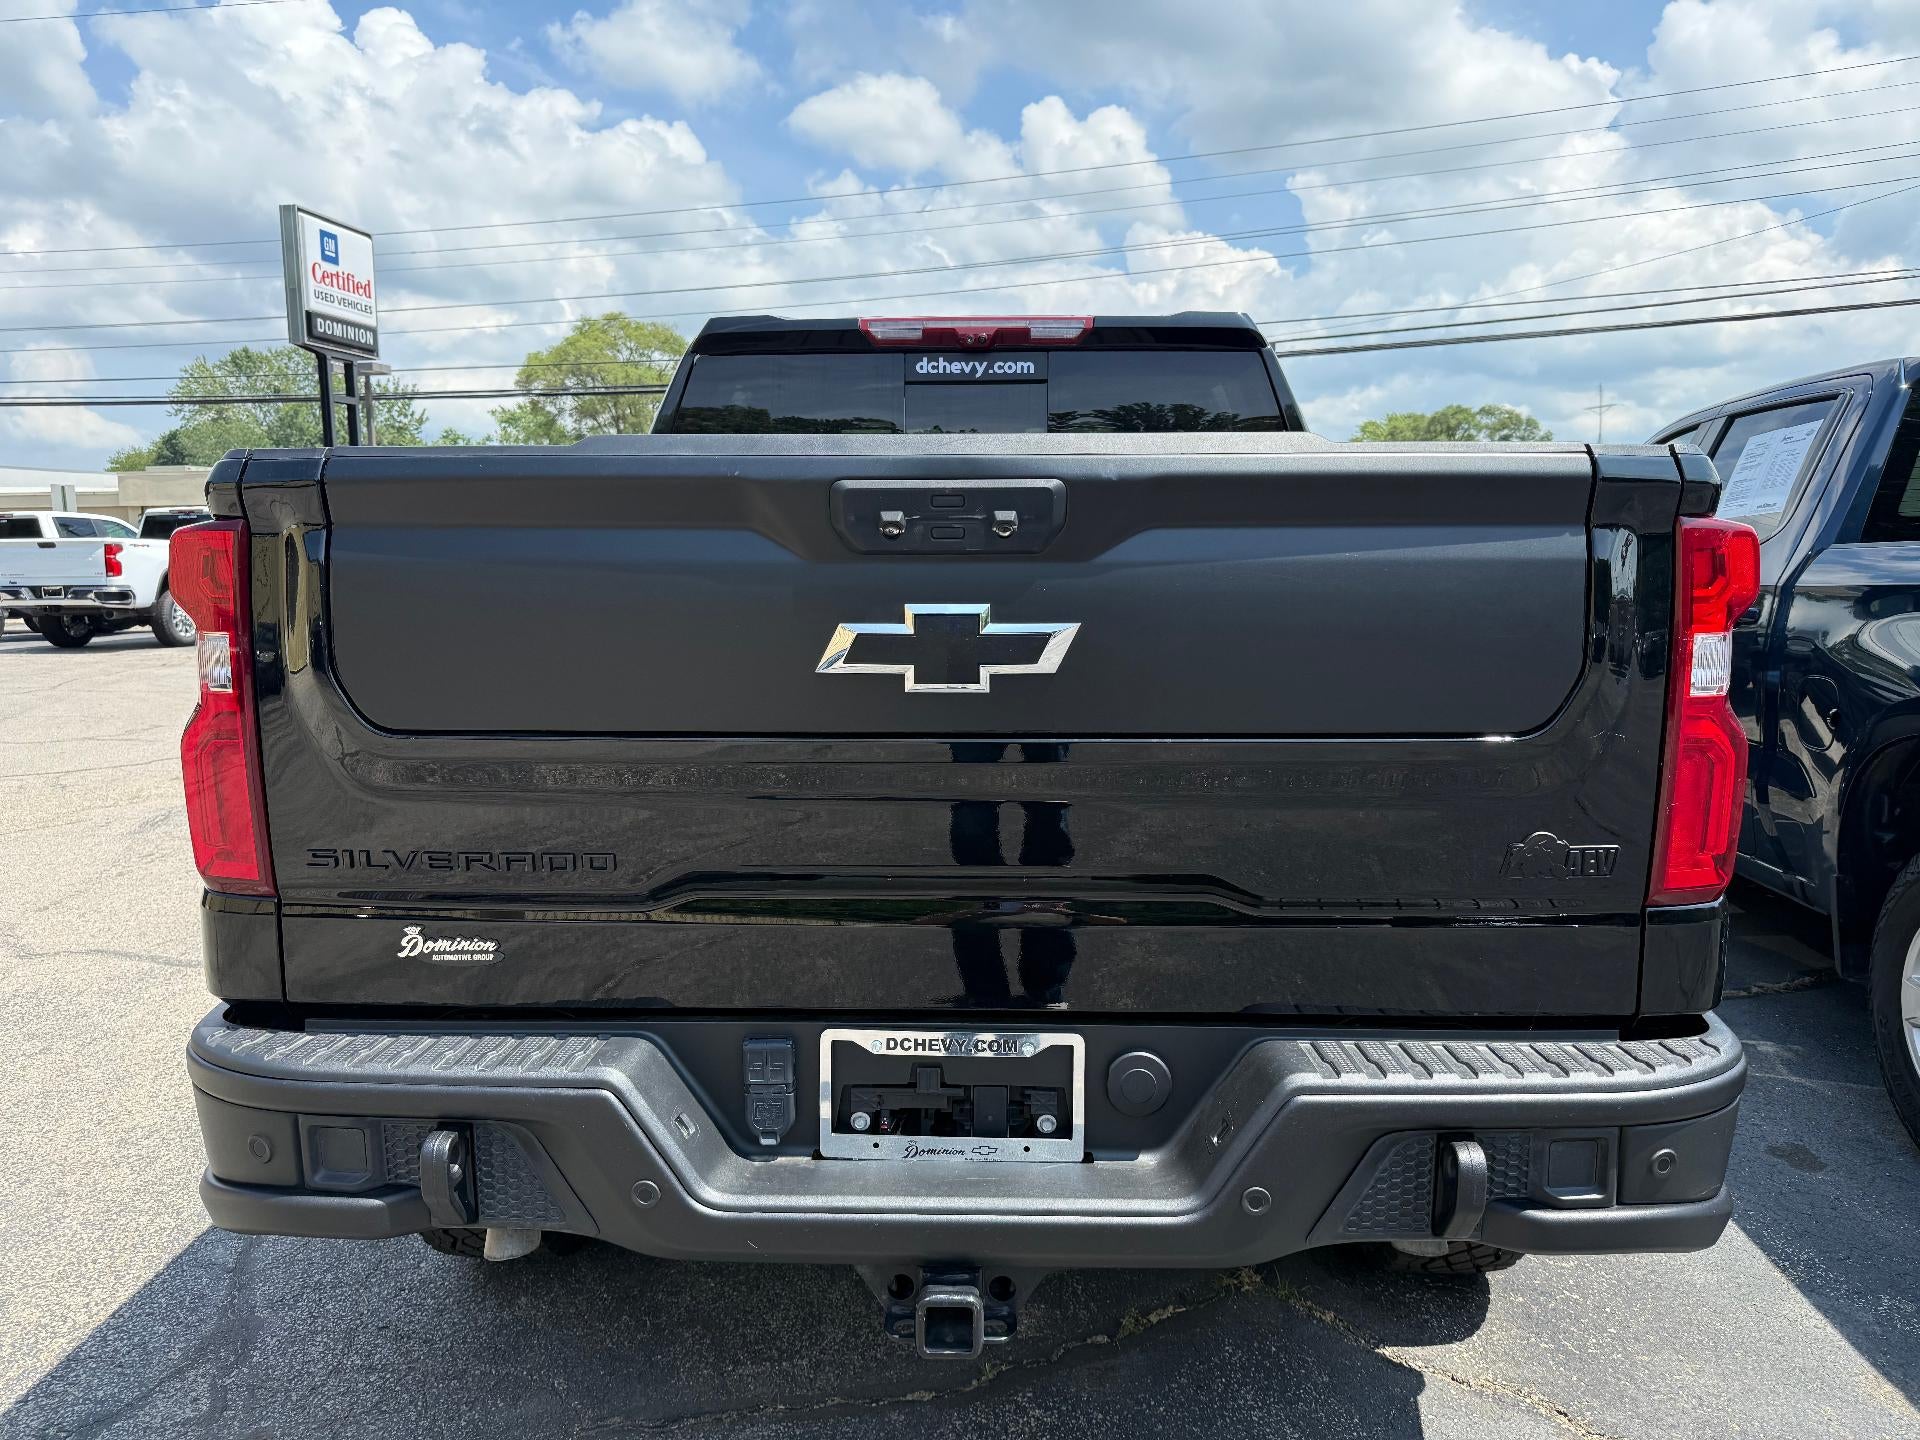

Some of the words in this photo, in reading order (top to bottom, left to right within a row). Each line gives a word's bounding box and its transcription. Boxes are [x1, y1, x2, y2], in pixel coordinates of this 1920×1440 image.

[324, 237, 336, 253] GM
[311, 262, 372, 299] Certified
[314, 289, 335, 304] USED
[336, 295, 373, 315] VEHICLES
[317, 317, 374, 346] DOMINION
[915, 356, 1035, 378] dchevy.com
[306, 848, 618, 873] SILVERADO
[397, 934, 498, 958] Dominion
[432, 953, 472, 961] AUTOMOTIVE
[473, 953, 495, 961] GROUP
[886, 1037, 1019, 1054] DCHEVY.COM
[902, 1144, 966, 1159] Dominion
